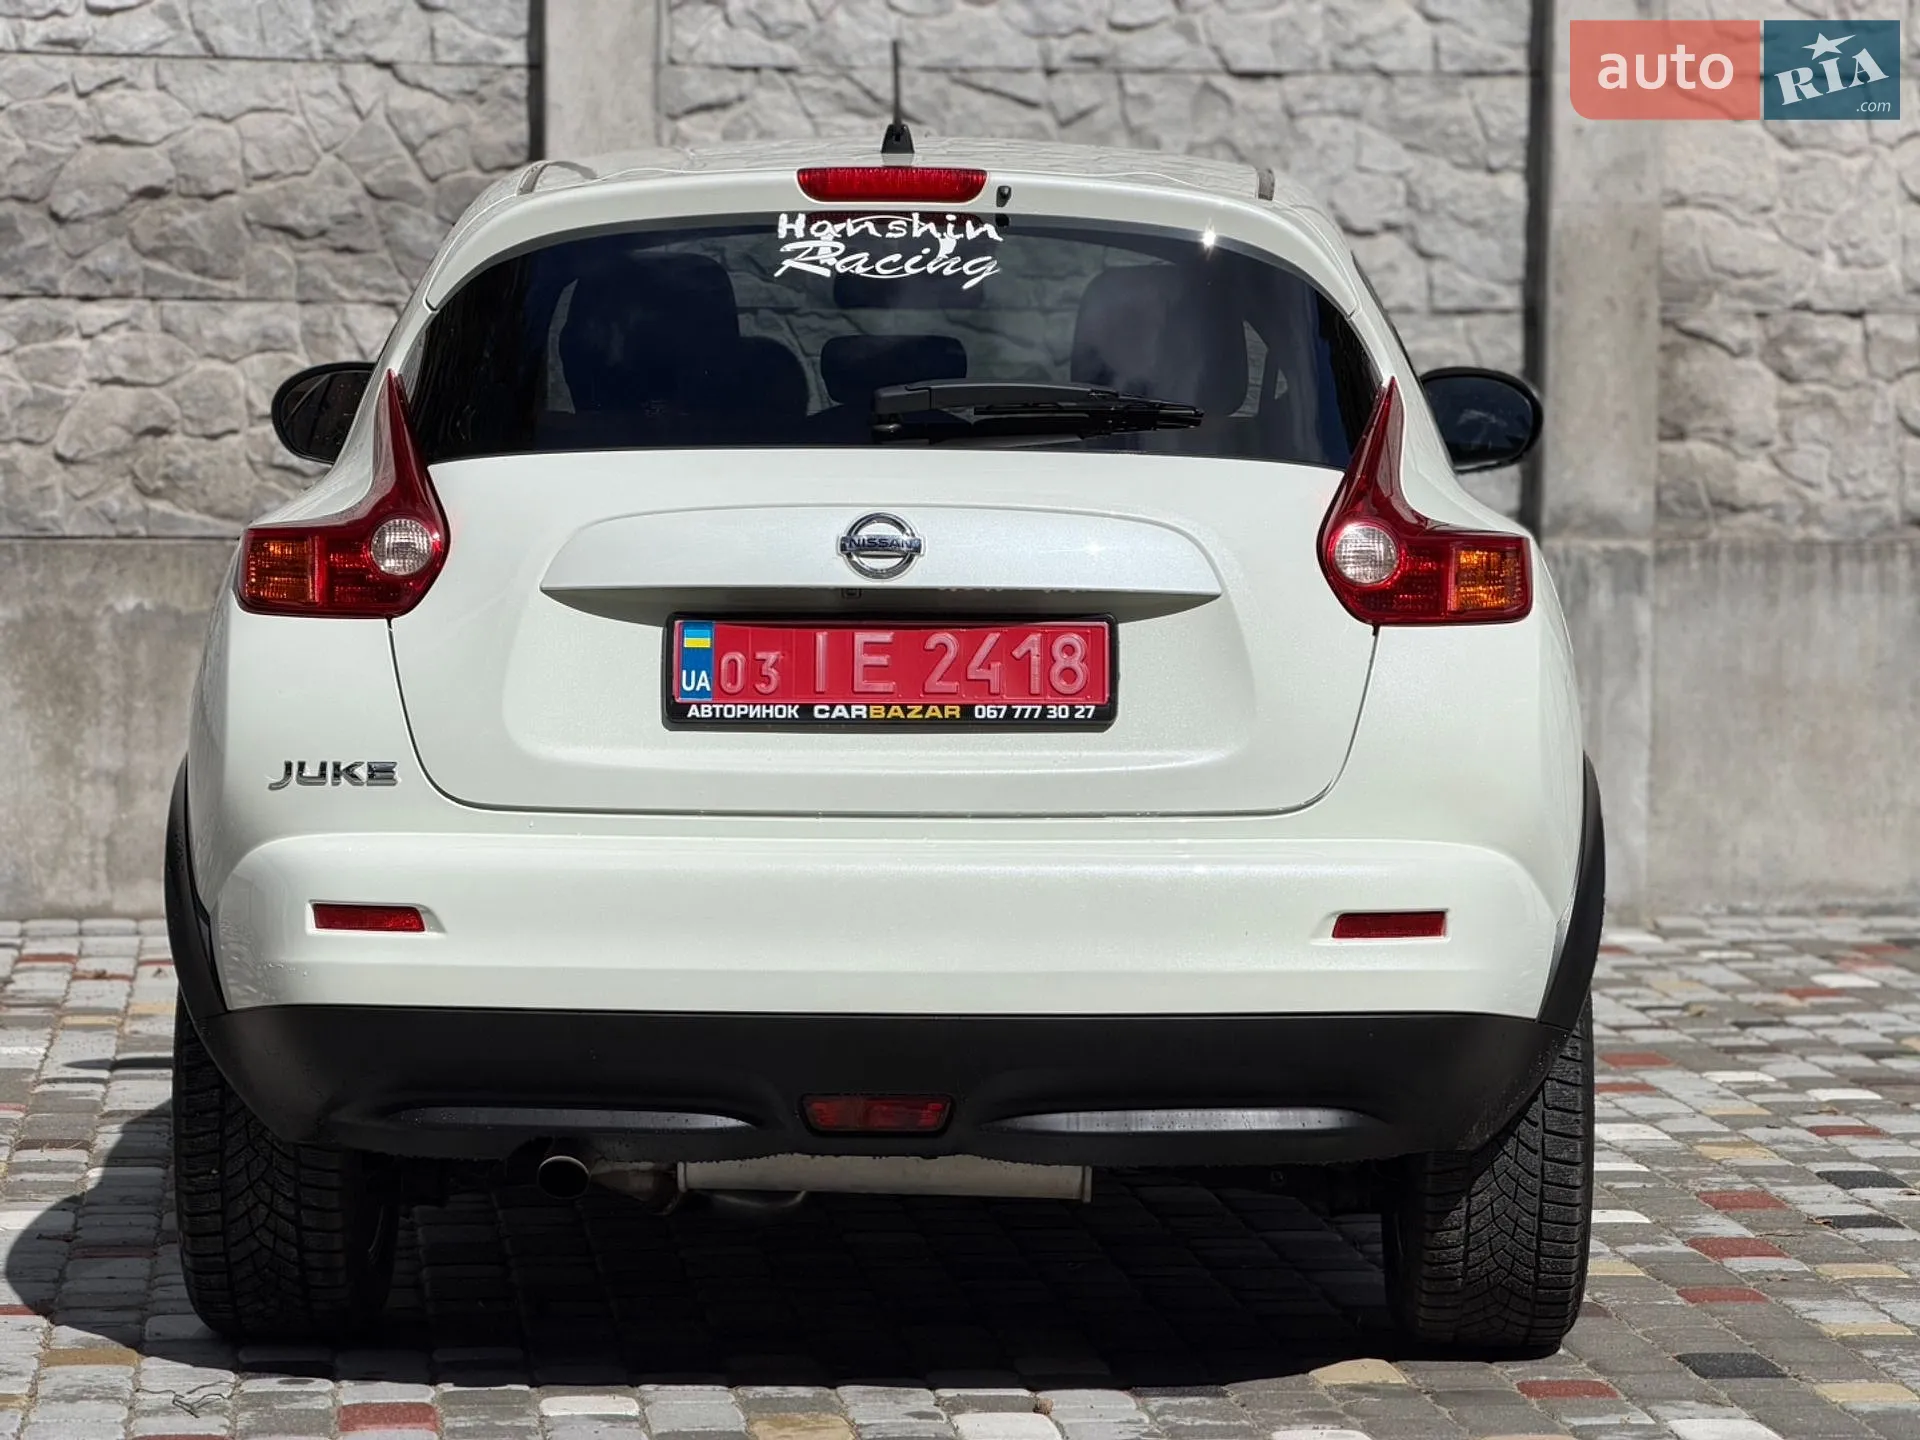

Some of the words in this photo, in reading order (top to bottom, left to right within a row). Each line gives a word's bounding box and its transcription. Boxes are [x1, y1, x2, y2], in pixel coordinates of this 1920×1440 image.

[774, 240, 1001, 290] Racing
[848, 538, 913, 549] NISSAN
[719, 650, 785, 695] 03
[924, 631, 1090, 695] 2418
[681, 670, 711, 691] UA
[687, 704, 800, 719] АВТОРИНОК
[974, 705, 1007, 719] 067
[1012, 705, 1042, 719] 777
[1046, 705, 1069, 719] 30
[1074, 705, 1096, 719] 27
[268, 761, 398, 791] JUKE
